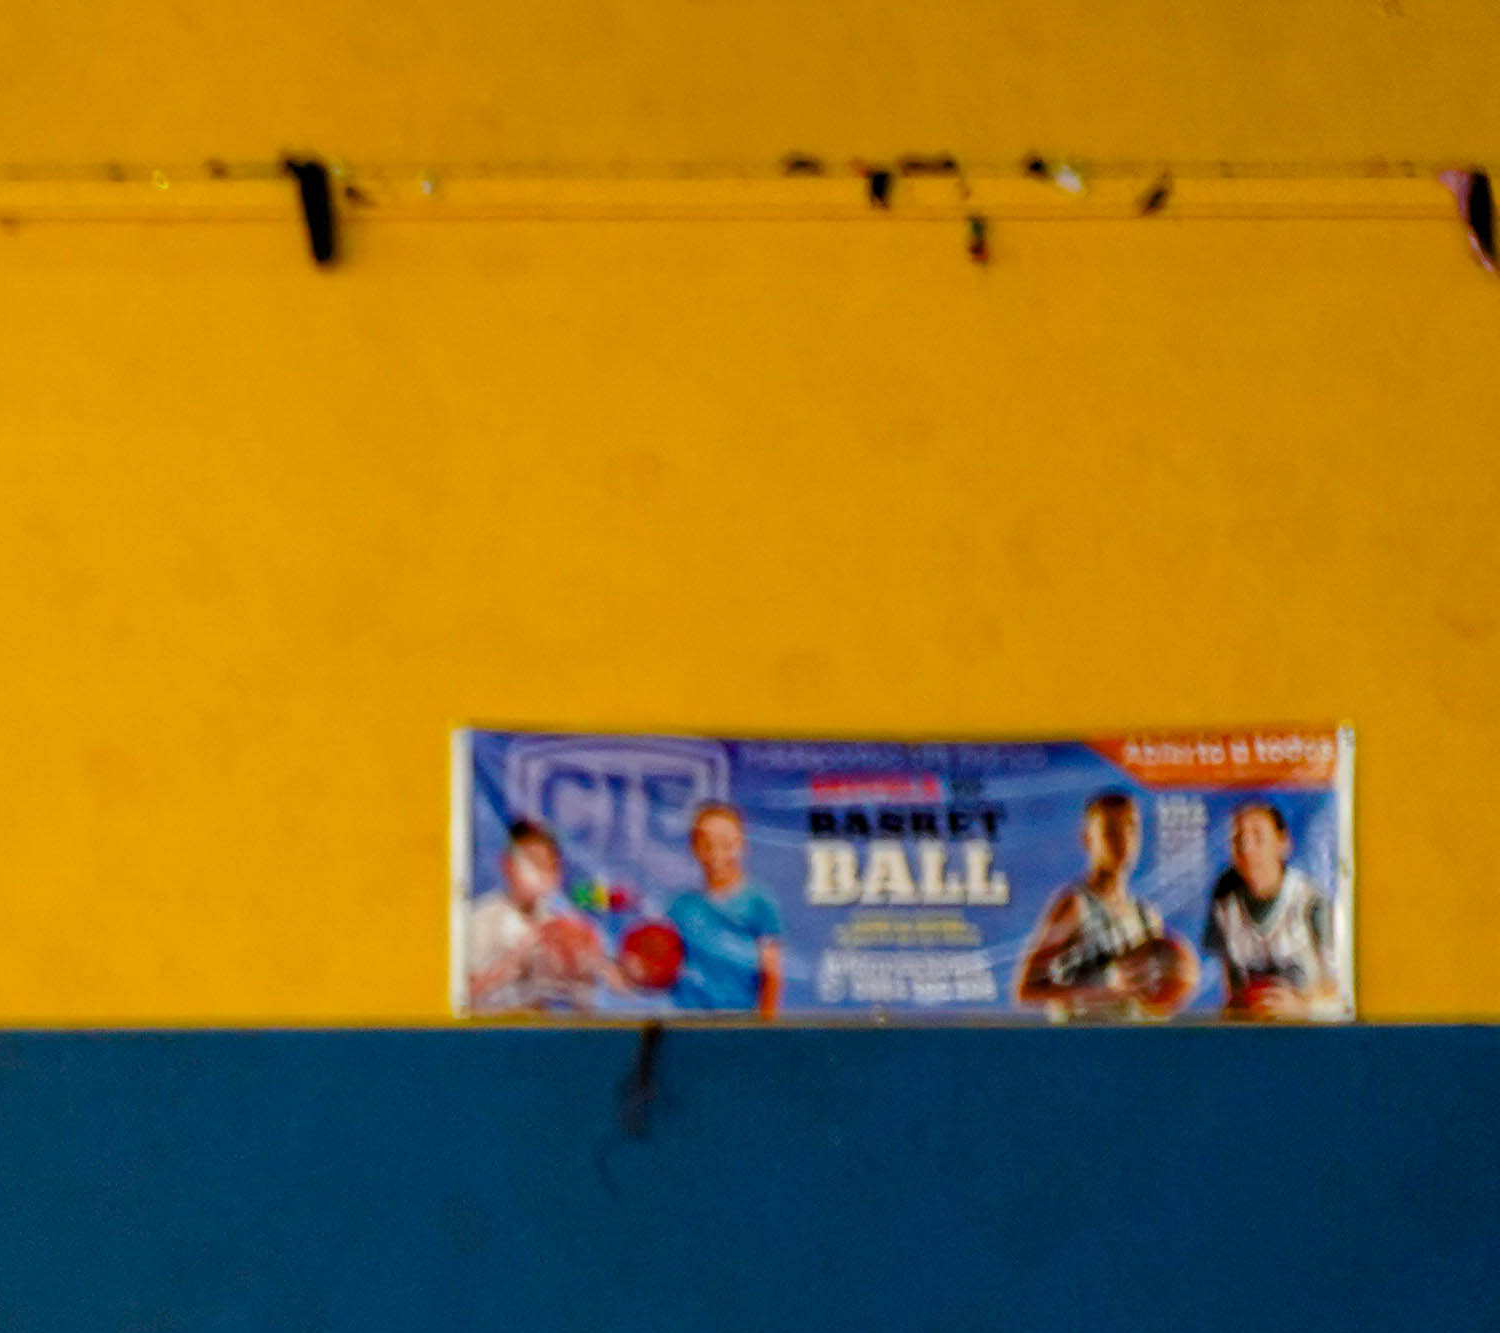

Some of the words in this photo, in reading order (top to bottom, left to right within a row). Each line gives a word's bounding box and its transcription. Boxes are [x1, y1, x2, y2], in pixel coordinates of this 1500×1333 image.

[1122, 736, 1227, 766] Abierto
[1253, 733, 1335, 764] todos
[808, 807, 1006, 837] BASKET
[808, 840, 1011, 907] BALL
